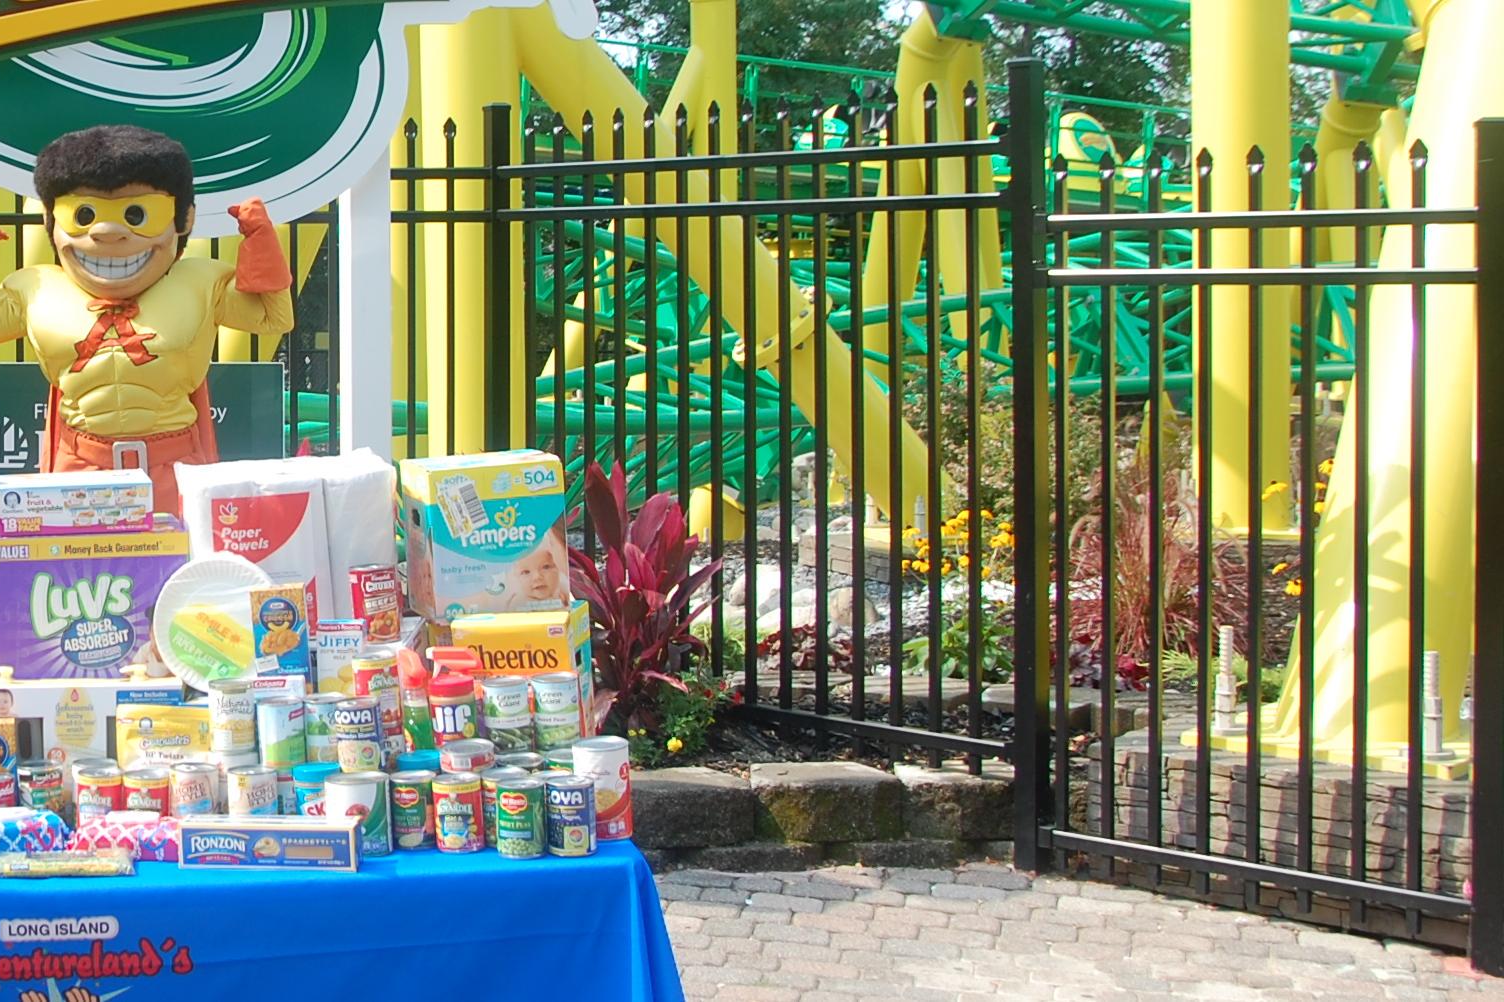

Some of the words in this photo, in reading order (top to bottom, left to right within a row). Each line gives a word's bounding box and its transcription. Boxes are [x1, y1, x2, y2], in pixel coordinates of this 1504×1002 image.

[524, 470, 555, 485] 504
[1, 518, 17, 533] 18
[220, 527, 262, 540] Paper
[64, 544, 92, 555] Money
[93, 544, 114, 553] Back
[222, 538, 269, 551] Towels
[76, 620, 113, 637] SUPER
[64, 630, 129, 651] ABSORBENT
[319, 635, 359, 647] JIFFY
[335, 710, 371, 724] GOYA
[433, 704, 471, 733] Jif
[547, 790, 582, 805] OYA
[191, 836, 245, 852] RONZONI
[8, 923, 51, 937] LONG
[55, 921, 110, 936] ISLAND
